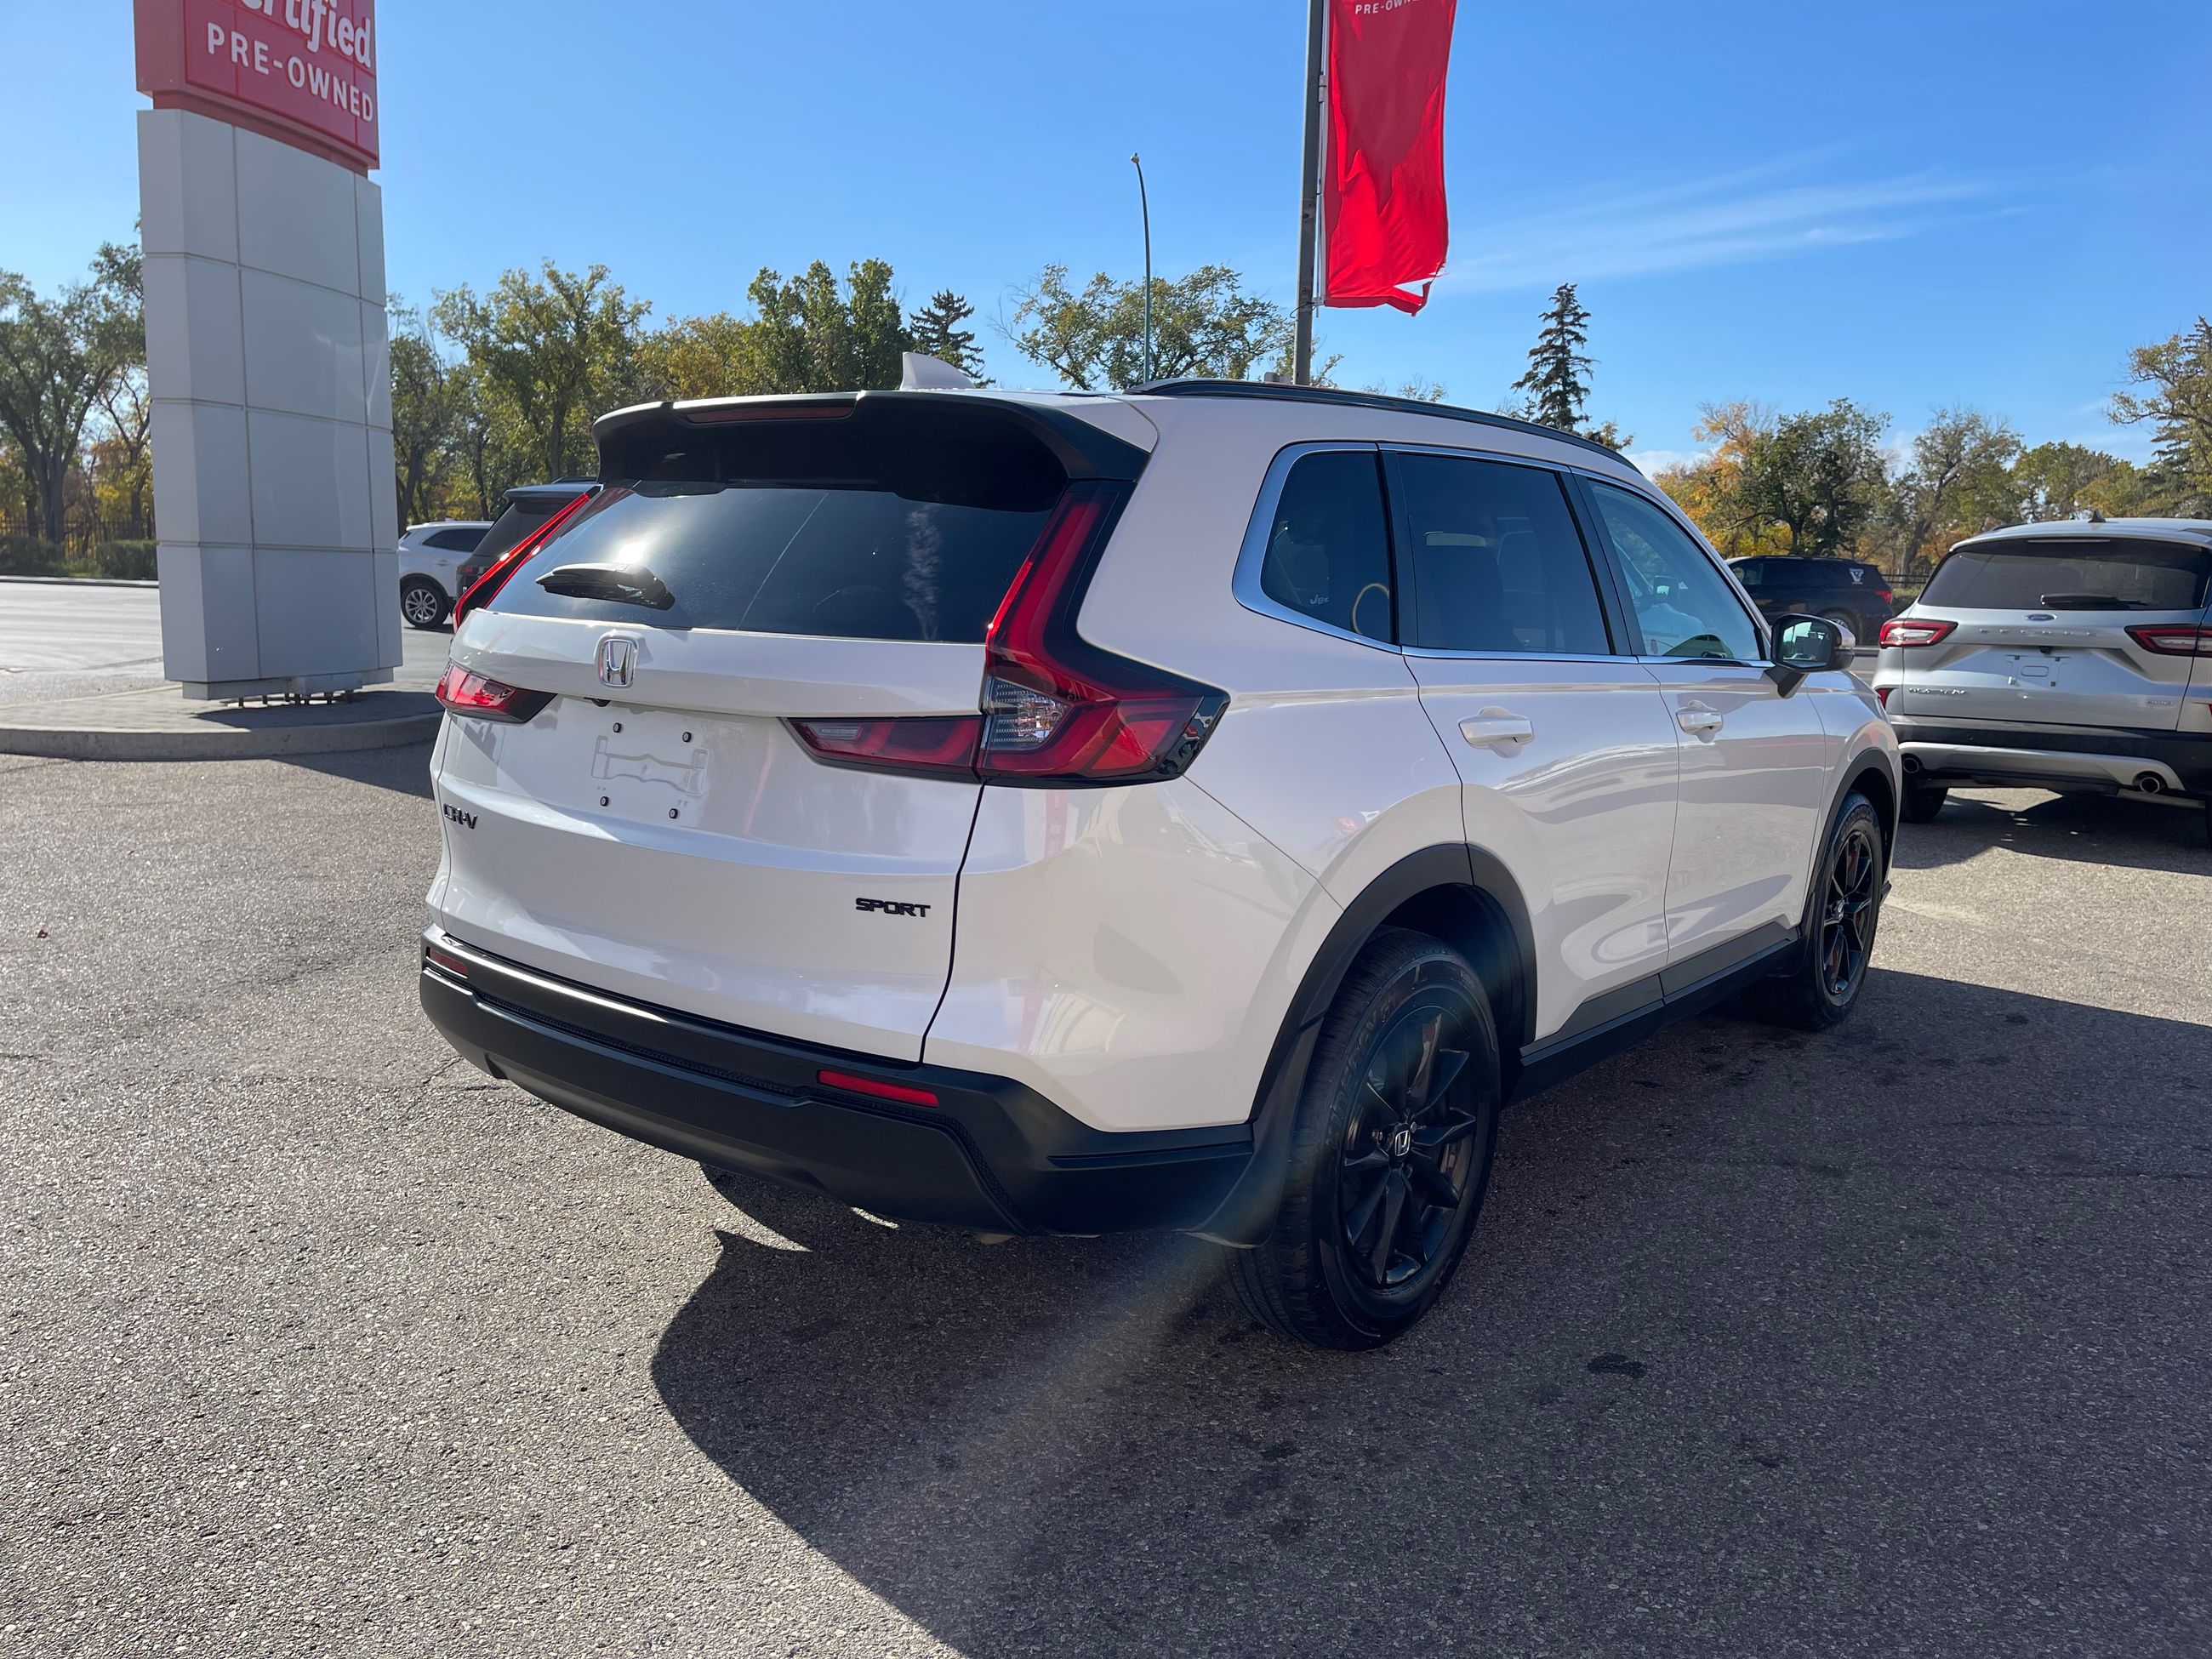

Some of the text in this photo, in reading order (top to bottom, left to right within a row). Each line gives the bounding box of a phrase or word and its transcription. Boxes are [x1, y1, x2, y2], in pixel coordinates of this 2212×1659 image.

[1354, 0, 1419, 14] PRE-OW
[207, 22, 373, 122] PRE-OWNED
[443, 803, 478, 829] CR-V
[856, 898, 931, 917] SPORT
